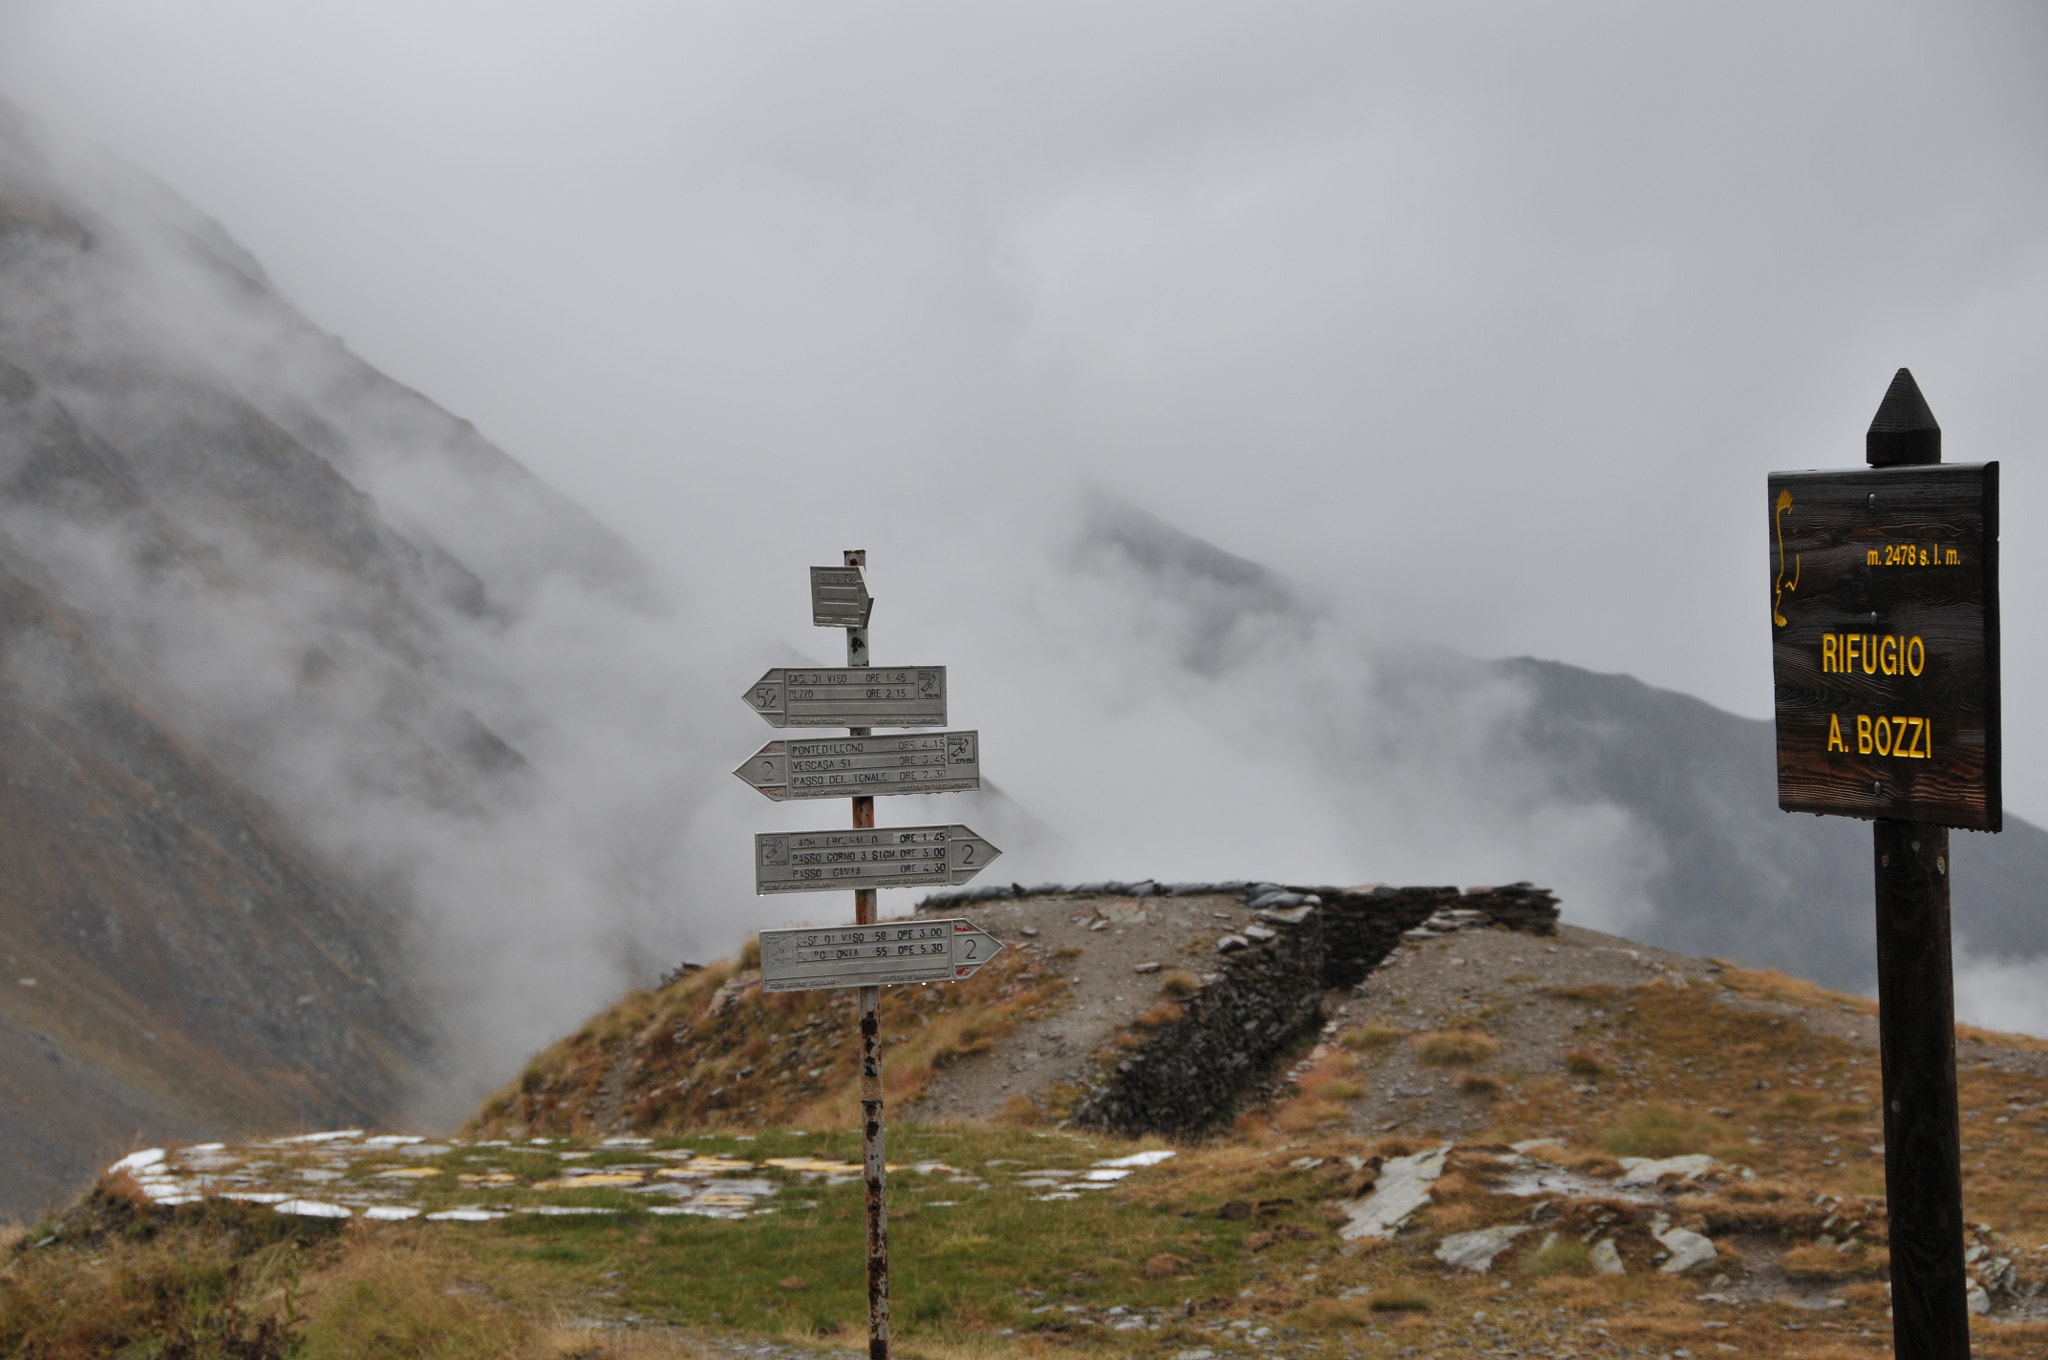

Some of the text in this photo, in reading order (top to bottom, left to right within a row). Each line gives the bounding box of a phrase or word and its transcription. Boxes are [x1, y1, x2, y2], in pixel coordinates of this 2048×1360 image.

[1866, 551, 1882, 566] m.
[1885, 545, 1917, 567] 2478
[1945, 550, 1962, 566] m.
[1822, 633, 1925, 677] RIFUGIO
[827, 673, 847, 684] VISO
[865, 672, 881, 683] ORE
[756, 688, 777, 709] 52
[866, 688, 881, 698] ORE
[1827, 713, 1932, 760] A. BOZZI
[899, 755, 916, 766] ORE
[922, 754, 946, 764] 3.45
[760, 761, 775, 782] 2
[793, 776, 824, 786] PASSO
[829, 774, 847, 785] DEL
[900, 770, 917, 781] ORE
[899, 833, 917, 843] ORE
[793, 853, 822, 864] PASSO
[826, 851, 856, 862] CORNO
[900, 848, 917, 858] ORE
[962, 843, 975, 865] 2
[792, 868, 822, 879] PASSO
[900, 864, 917, 873] ORE
[796, 935, 818, 946] CSE
[841, 932, 865, 943] VISO
[965, 938, 977, 960] 2
